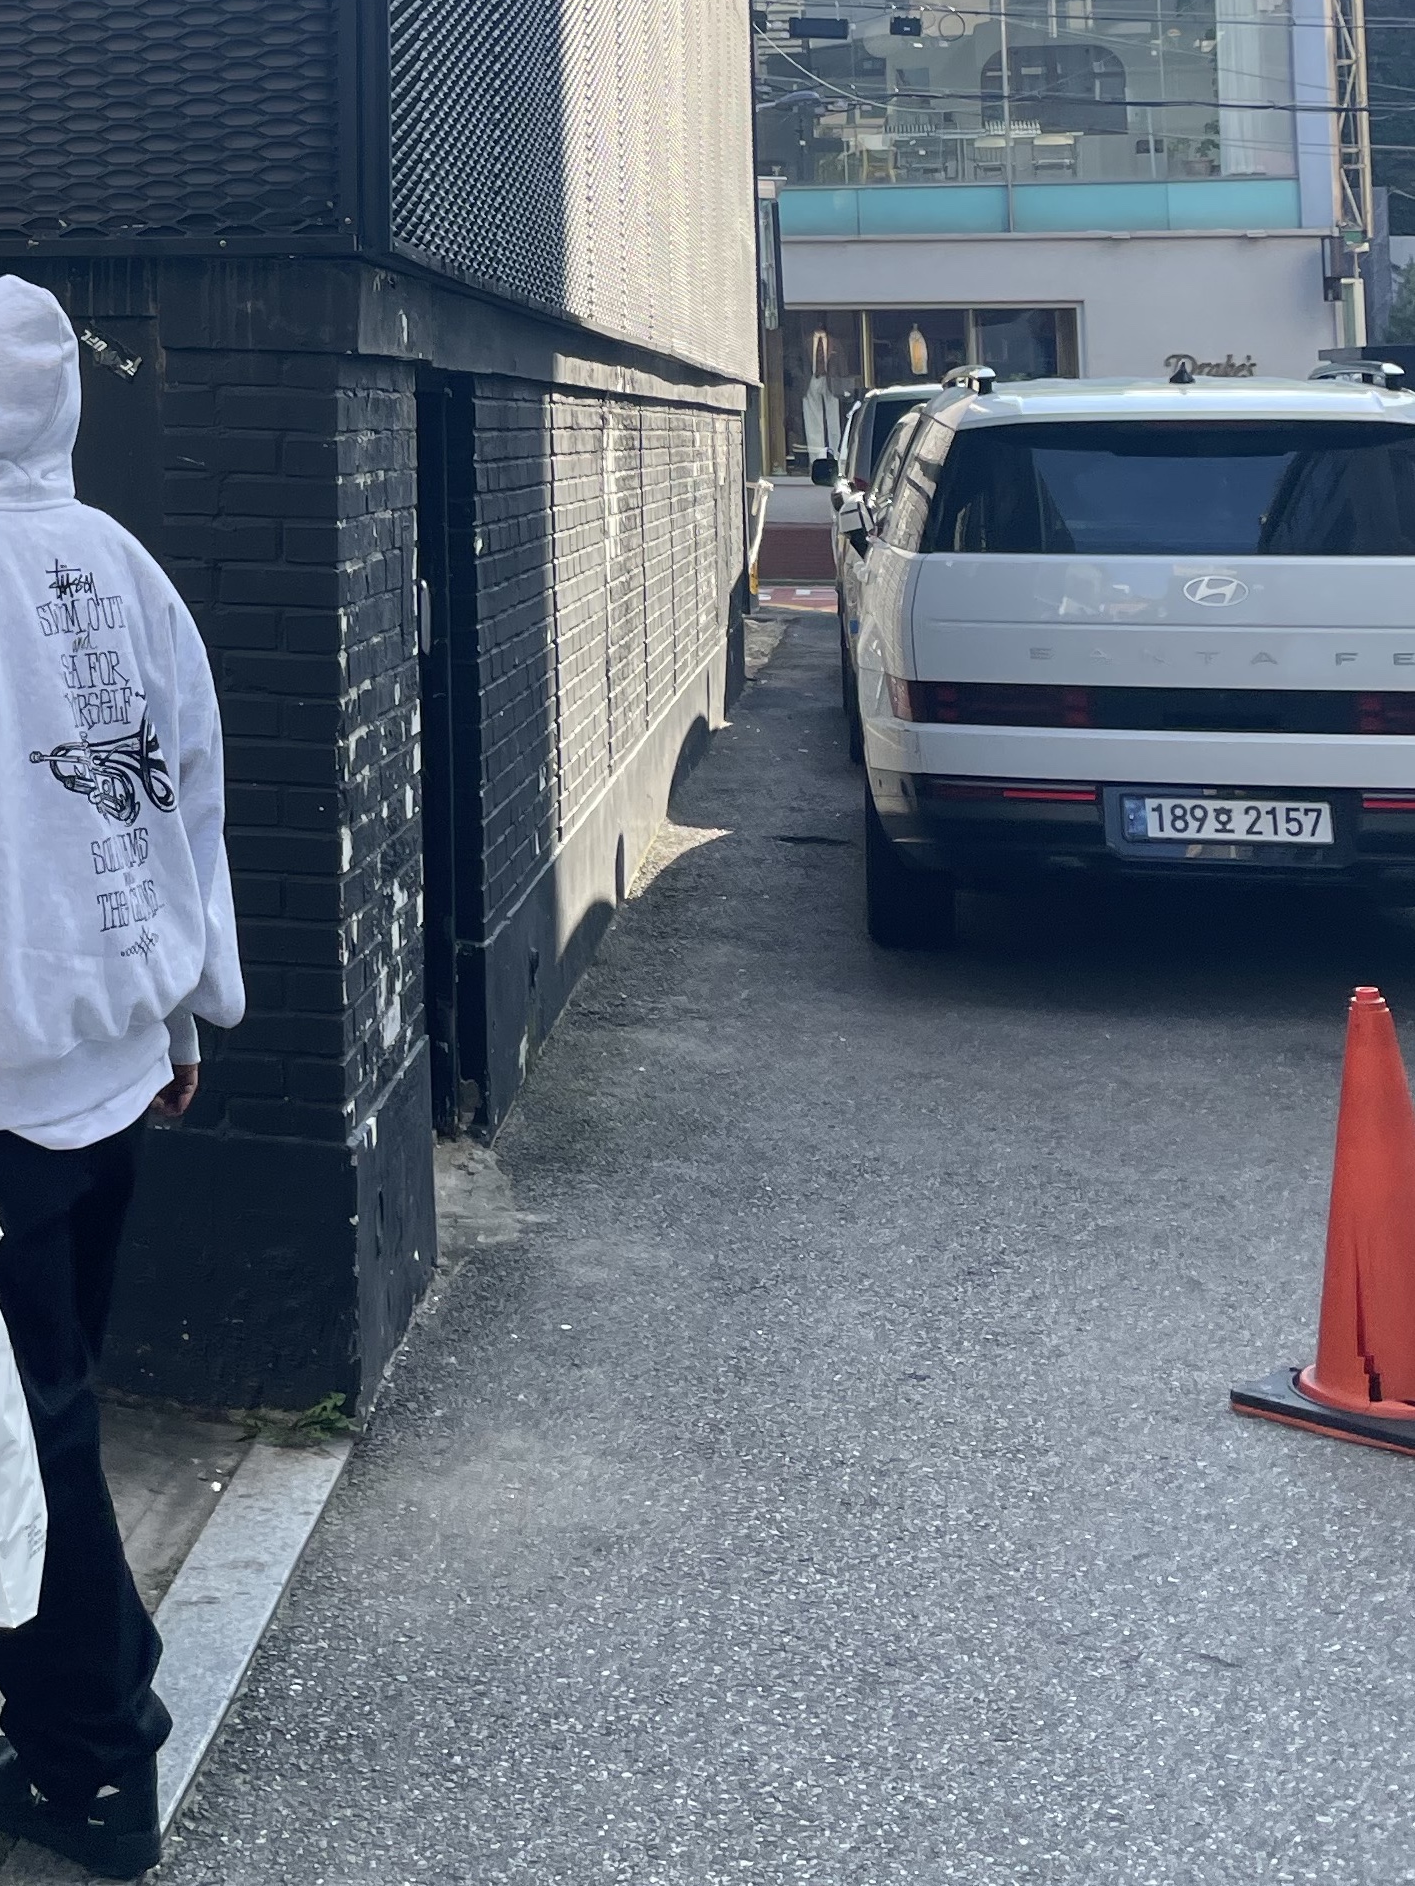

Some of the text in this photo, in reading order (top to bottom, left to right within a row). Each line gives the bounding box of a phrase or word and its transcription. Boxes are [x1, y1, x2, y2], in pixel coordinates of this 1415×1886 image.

[80, 329, 108, 352] UFC
[87, 595, 126, 632] OUT
[85, 650, 131, 689] FOR
[1335, 651, 1415, 666] FE
[1244, 805, 1323, 837] 2157
